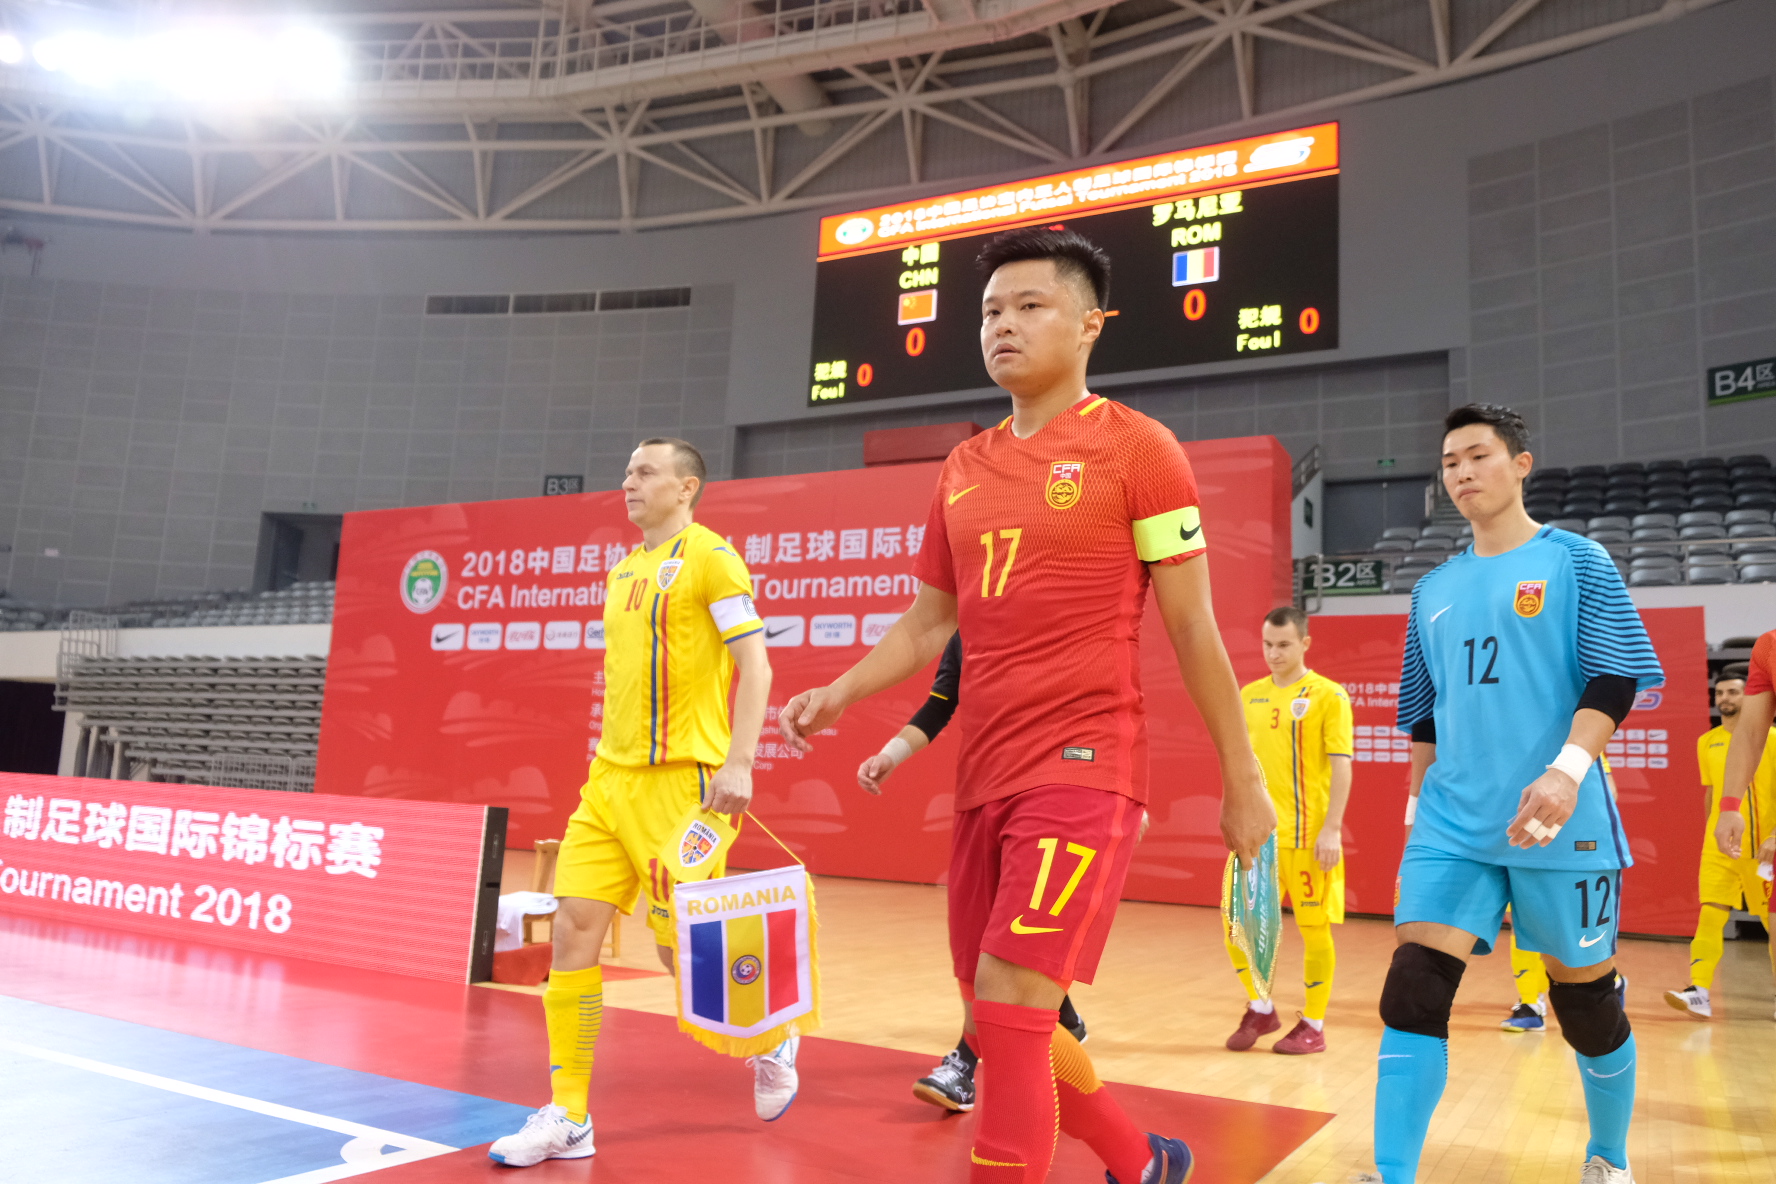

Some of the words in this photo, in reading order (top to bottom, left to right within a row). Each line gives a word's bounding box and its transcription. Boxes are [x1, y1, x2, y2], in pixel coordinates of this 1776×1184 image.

[1152, 190, 1244, 227] 罗马尼亚
[1171, 221, 1222, 247] ROM
[901, 242, 940, 266] 中国
[899, 267, 939, 289] CHN
[1183, 288, 1207, 321] 0
[1299, 307, 1320, 335] 0
[905, 327, 926, 357] 0
[1236, 329, 1281, 352] Foul
[857, 363, 874, 387] 0
[811, 382, 845, 401] Foul
[1053, 463, 1081, 474] CFA
[980, 528, 1023, 598] 17
[457, 585, 505, 610] CFA
[624, 578, 648, 612] 10
[814, 622, 852, 630] SKYWORTH
[1464, 636, 1499, 685] 12
[1271, 708, 1280, 729] 3
[3, 794, 385, 879] 制足球国际锦标赛
[1029, 838, 1097, 917] 17
[1299, 871, 1314, 898] 3
[0, 859, 184, 918] ournament
[190, 884, 293, 934] 2018
[687, 885, 797, 917] ROMANIA
[1575, 875, 1610, 929] 12
